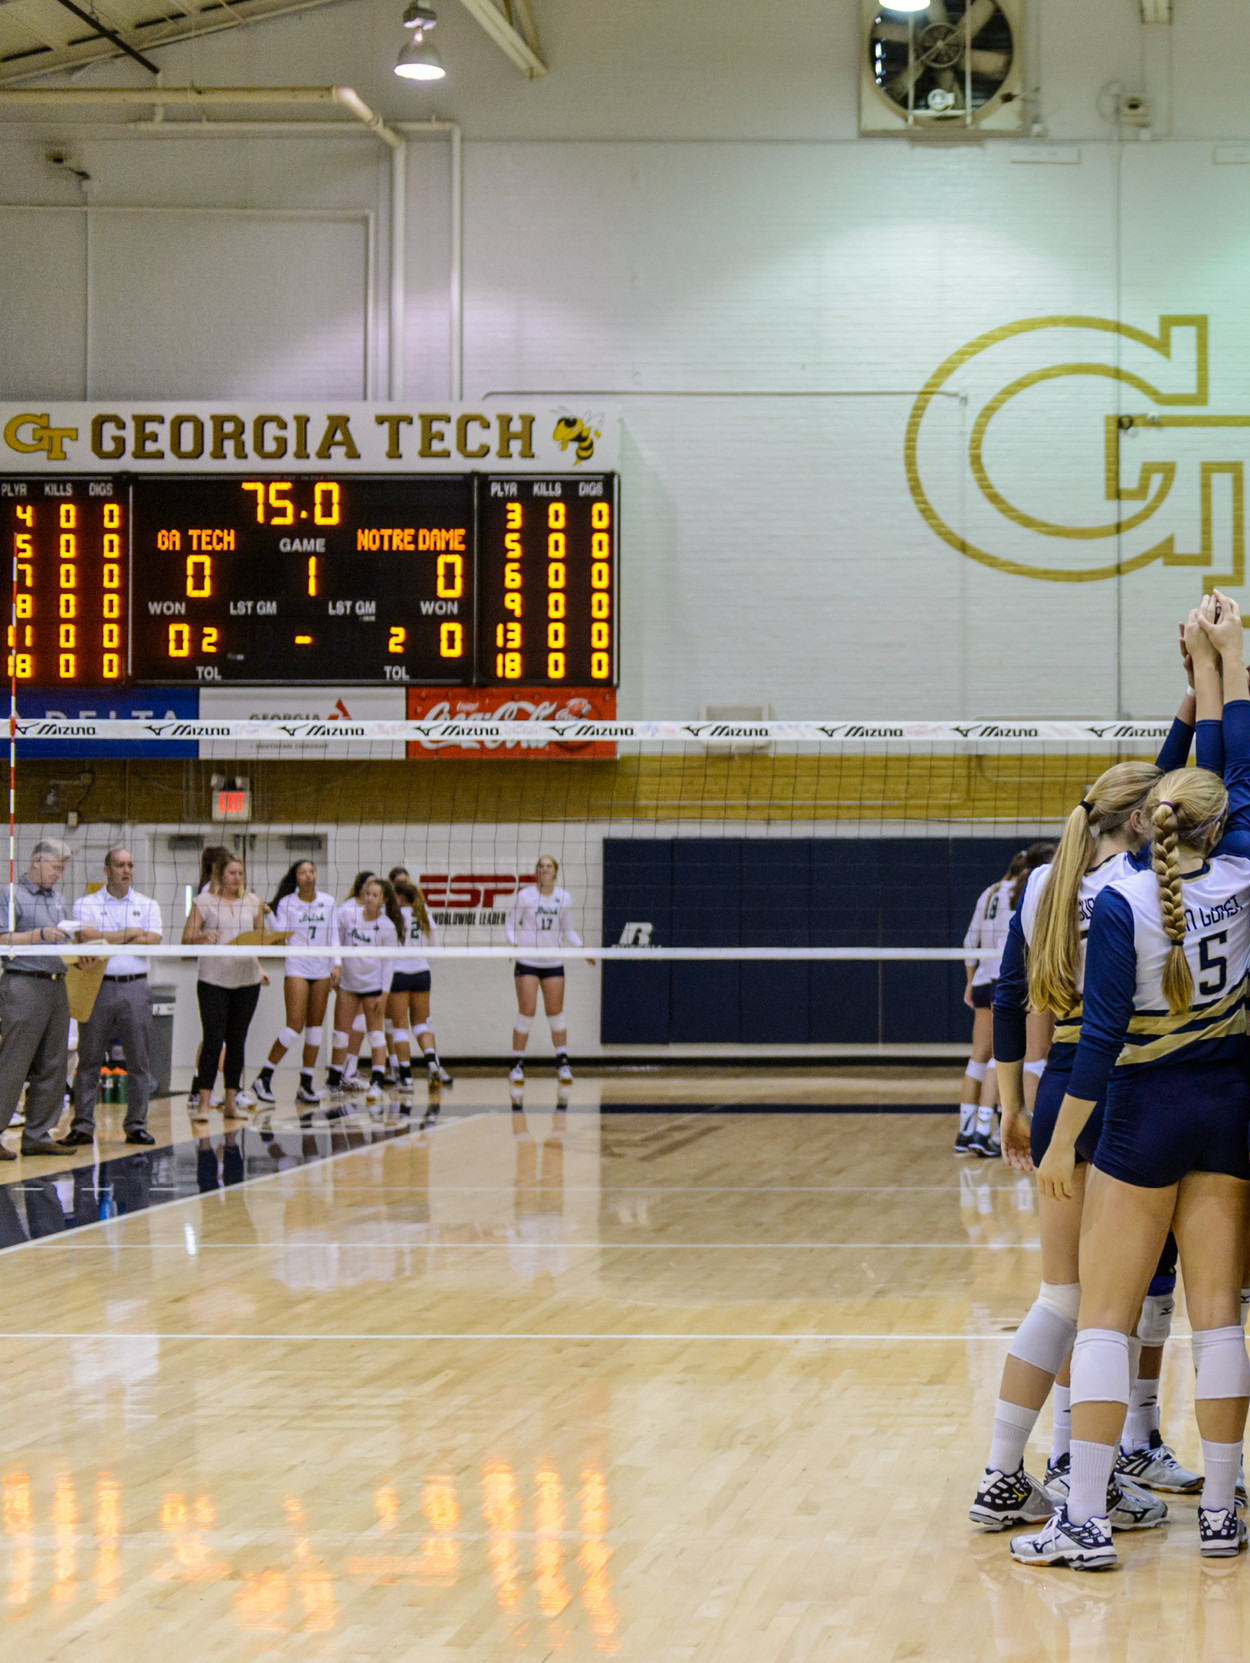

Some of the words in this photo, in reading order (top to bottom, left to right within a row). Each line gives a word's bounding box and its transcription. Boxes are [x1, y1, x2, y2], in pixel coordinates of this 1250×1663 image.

[91, 413, 361, 460] GEORGIA
[374, 413, 535, 459] TECH
[1, 483, 27, 496] PLYR
[44, 483, 73, 496] KILLS
[89, 483, 113, 496] DIGS
[491, 482, 517, 496] PLYR
[533, 482, 562, 496] KILLS
[579, 482, 603, 496] DIGS
[16, 504, 33, 528] 4
[59, 504, 76, 528] 0
[103, 504, 119, 528] 0
[241, 482, 340, 525] 75.0
[505, 502, 523, 529] 3
[548, 502, 566, 529] 0
[591, 502, 609, 529] 0
[16, 534, 32, 558] 5
[59, 534, 76, 558] 0
[103, 534, 119, 558] 0
[157, 529, 181, 551] GA
[187, 529, 236, 551] TECH
[279, 538, 326, 552] GAME
[357, 528, 415, 551] NOTRE
[417, 528, 466, 551] DAME
[505, 532, 523, 559] 5
[548, 532, 566, 559] 0
[591, 532, 609, 559] 0
[17, 564, 33, 588] 7
[59, 564, 76, 588] 0
[103, 564, 119, 588] 0
[186, 554, 212, 597] 0
[307, 555, 318, 597] 1
[436, 554, 463, 598] 0
[504, 562, 522, 589] 6
[548, 562, 566, 589] 0
[591, 562, 609, 589] 0
[16, 594, 32, 618] 8
[59, 594, 76, 618] 0
[103, 594, 119, 618] 0
[148, 602, 186, 615] WON
[229, 602, 254, 615] LST
[256, 602, 277, 615] GM
[328, 601, 352, 615] LST
[355, 601, 376, 615] GM
[420, 601, 458, 615] WON
[504, 592, 522, 618] 9
[548, 592, 566, 618] 0
[591, 592, 609, 618] 0
[59, 623, 76, 648] 0
[103, 623, 119, 648] 0
[168, 623, 190, 657] 0
[202, 627, 218, 652] 2
[388, 626, 406, 653] 2
[440, 622, 463, 658] 0
[496, 622, 522, 649] 13
[548, 622, 566, 649] 0
[591, 622, 609, 649] 0
[59, 653, 76, 678] 0
[103, 653, 119, 678] 0
[196, 666, 222, 680] TOL
[384, 666, 410, 680] TOL
[496, 652, 522, 679] 18
[548, 652, 566, 679] 0
[591, 652, 609, 679] 0
[219, 792, 244, 813] EXIT
[419, 874, 539, 908] ESP
[1199, 929, 1229, 996] 5
